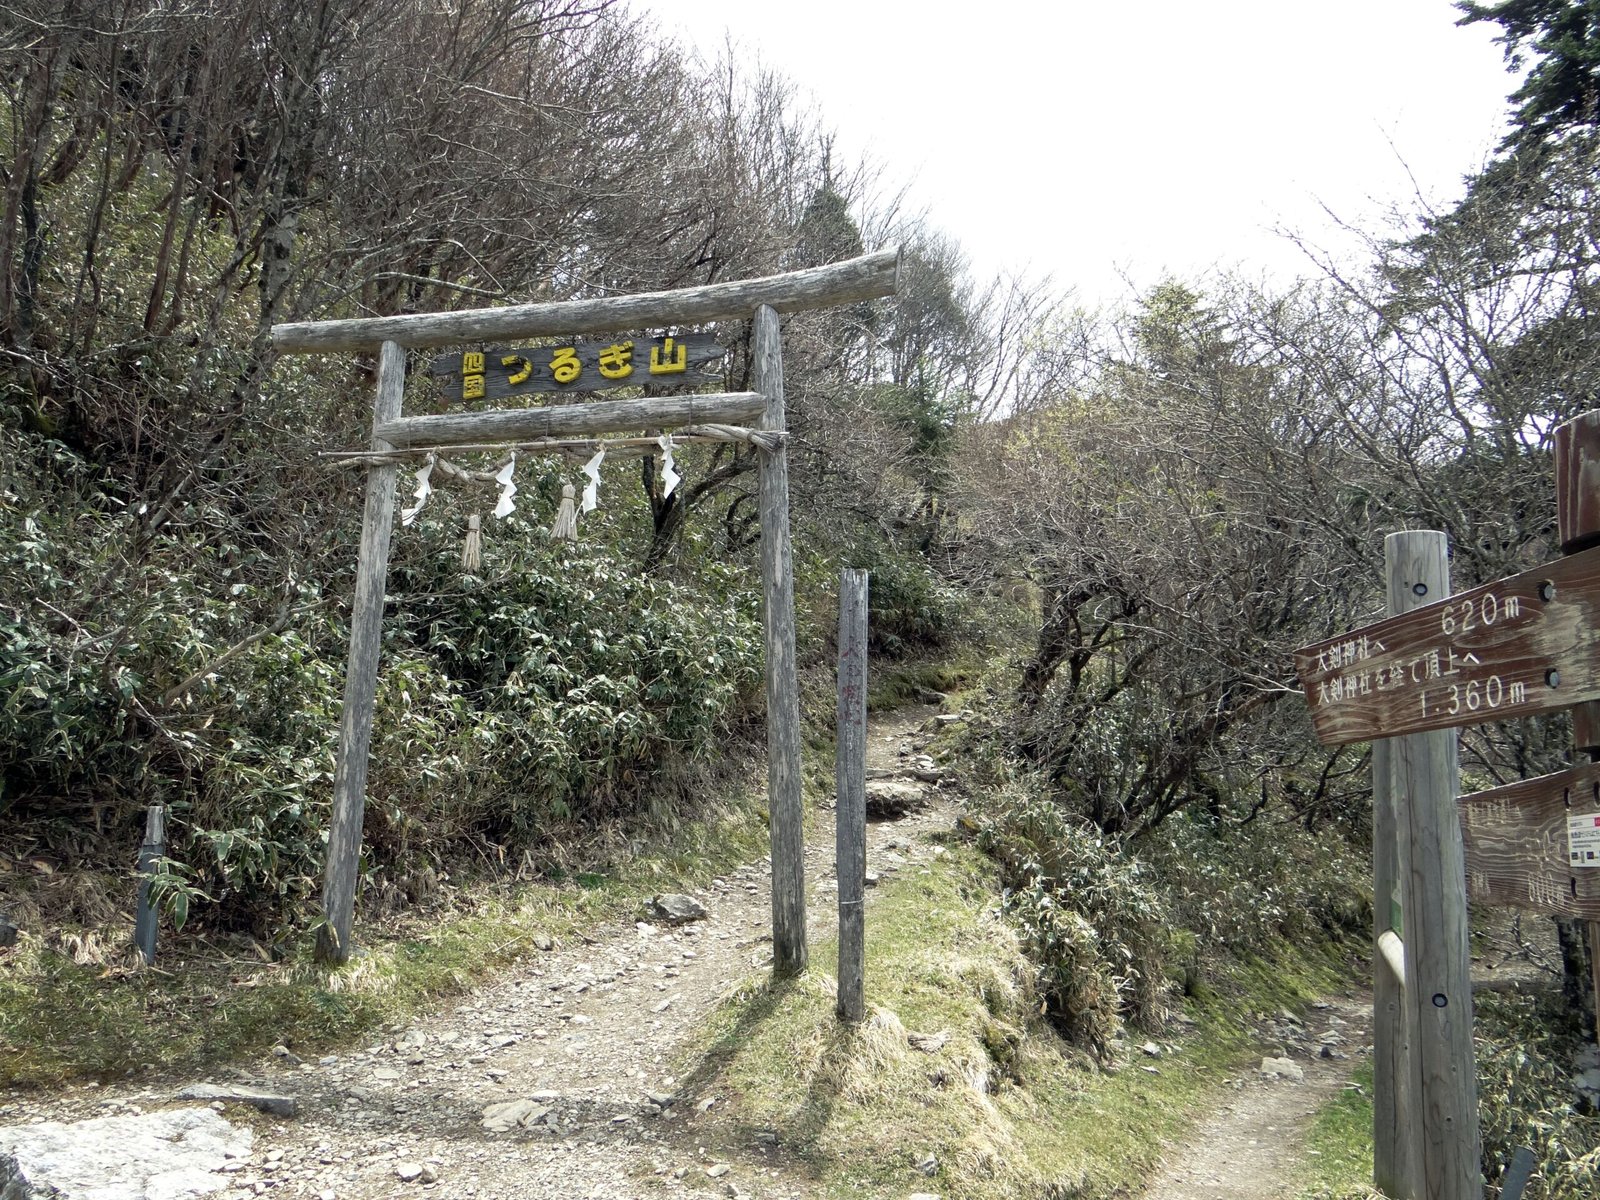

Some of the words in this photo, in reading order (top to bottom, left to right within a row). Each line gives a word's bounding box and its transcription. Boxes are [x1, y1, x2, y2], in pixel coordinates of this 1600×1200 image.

[462, 352, 486, 400] 四国
[501, 338, 689, 385] つるぎ山
[1441, 593, 1520, 635] 620m
[1315, 635, 1387, 673] 大剣神社へ
